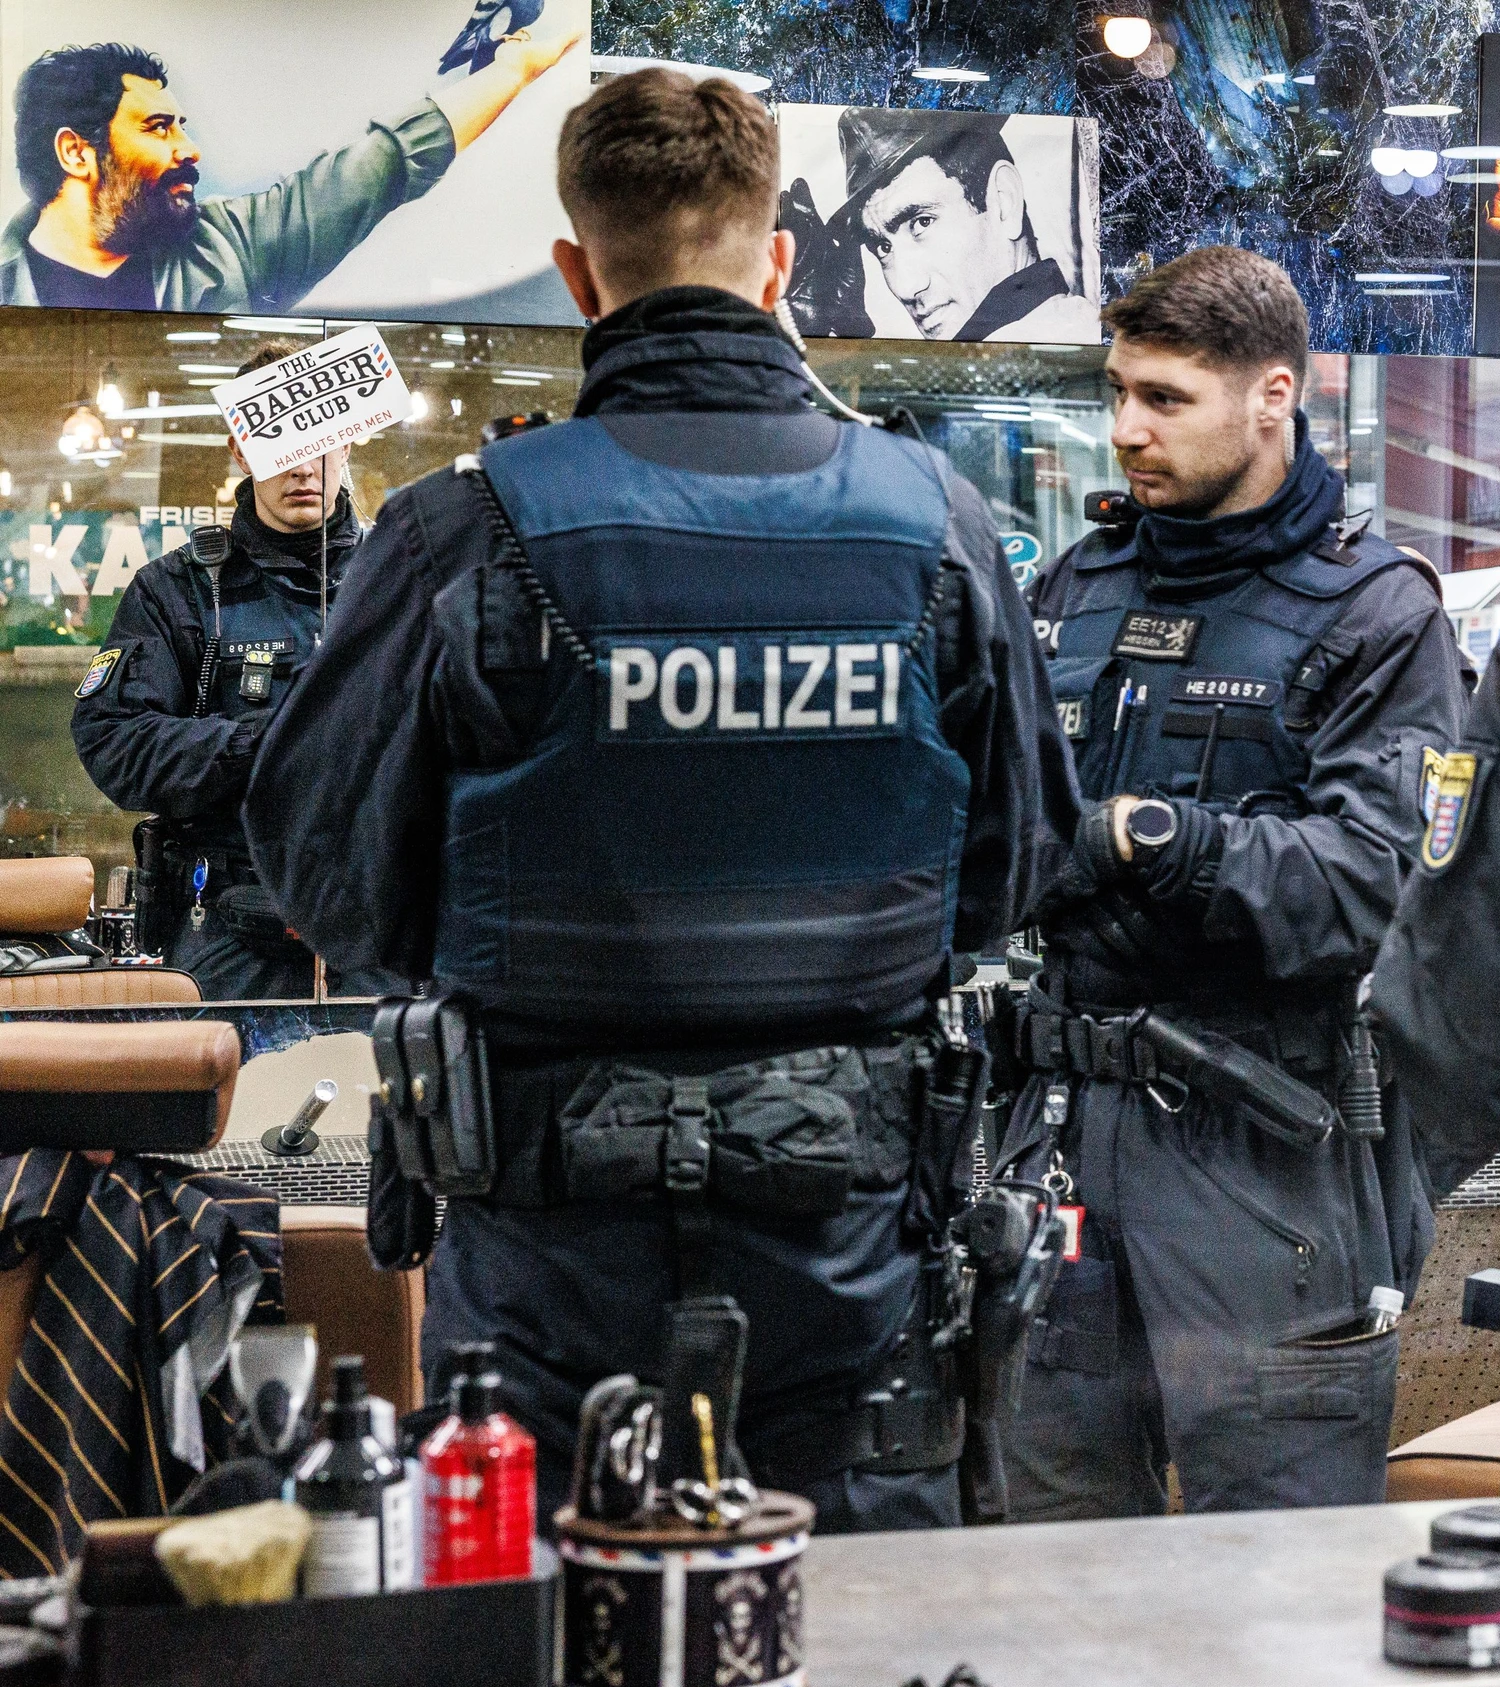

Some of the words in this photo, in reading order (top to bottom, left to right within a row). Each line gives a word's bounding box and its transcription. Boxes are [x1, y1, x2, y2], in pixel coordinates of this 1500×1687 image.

[277, 352, 317, 379] THE
[237, 352, 382, 433] BARBER
[292, 395, 351, 432] CLUB
[274, 435, 336, 469] HAIRCUTS
[337, 423, 363, 441] FOR
[365, 409, 393, 428] MEN
[139, 506, 235, 525] FRISE
[1128, 616, 1169, 635] EE12
[608, 642, 900, 731] POLIZEI
[1186, 680, 1267, 699] HE20657
